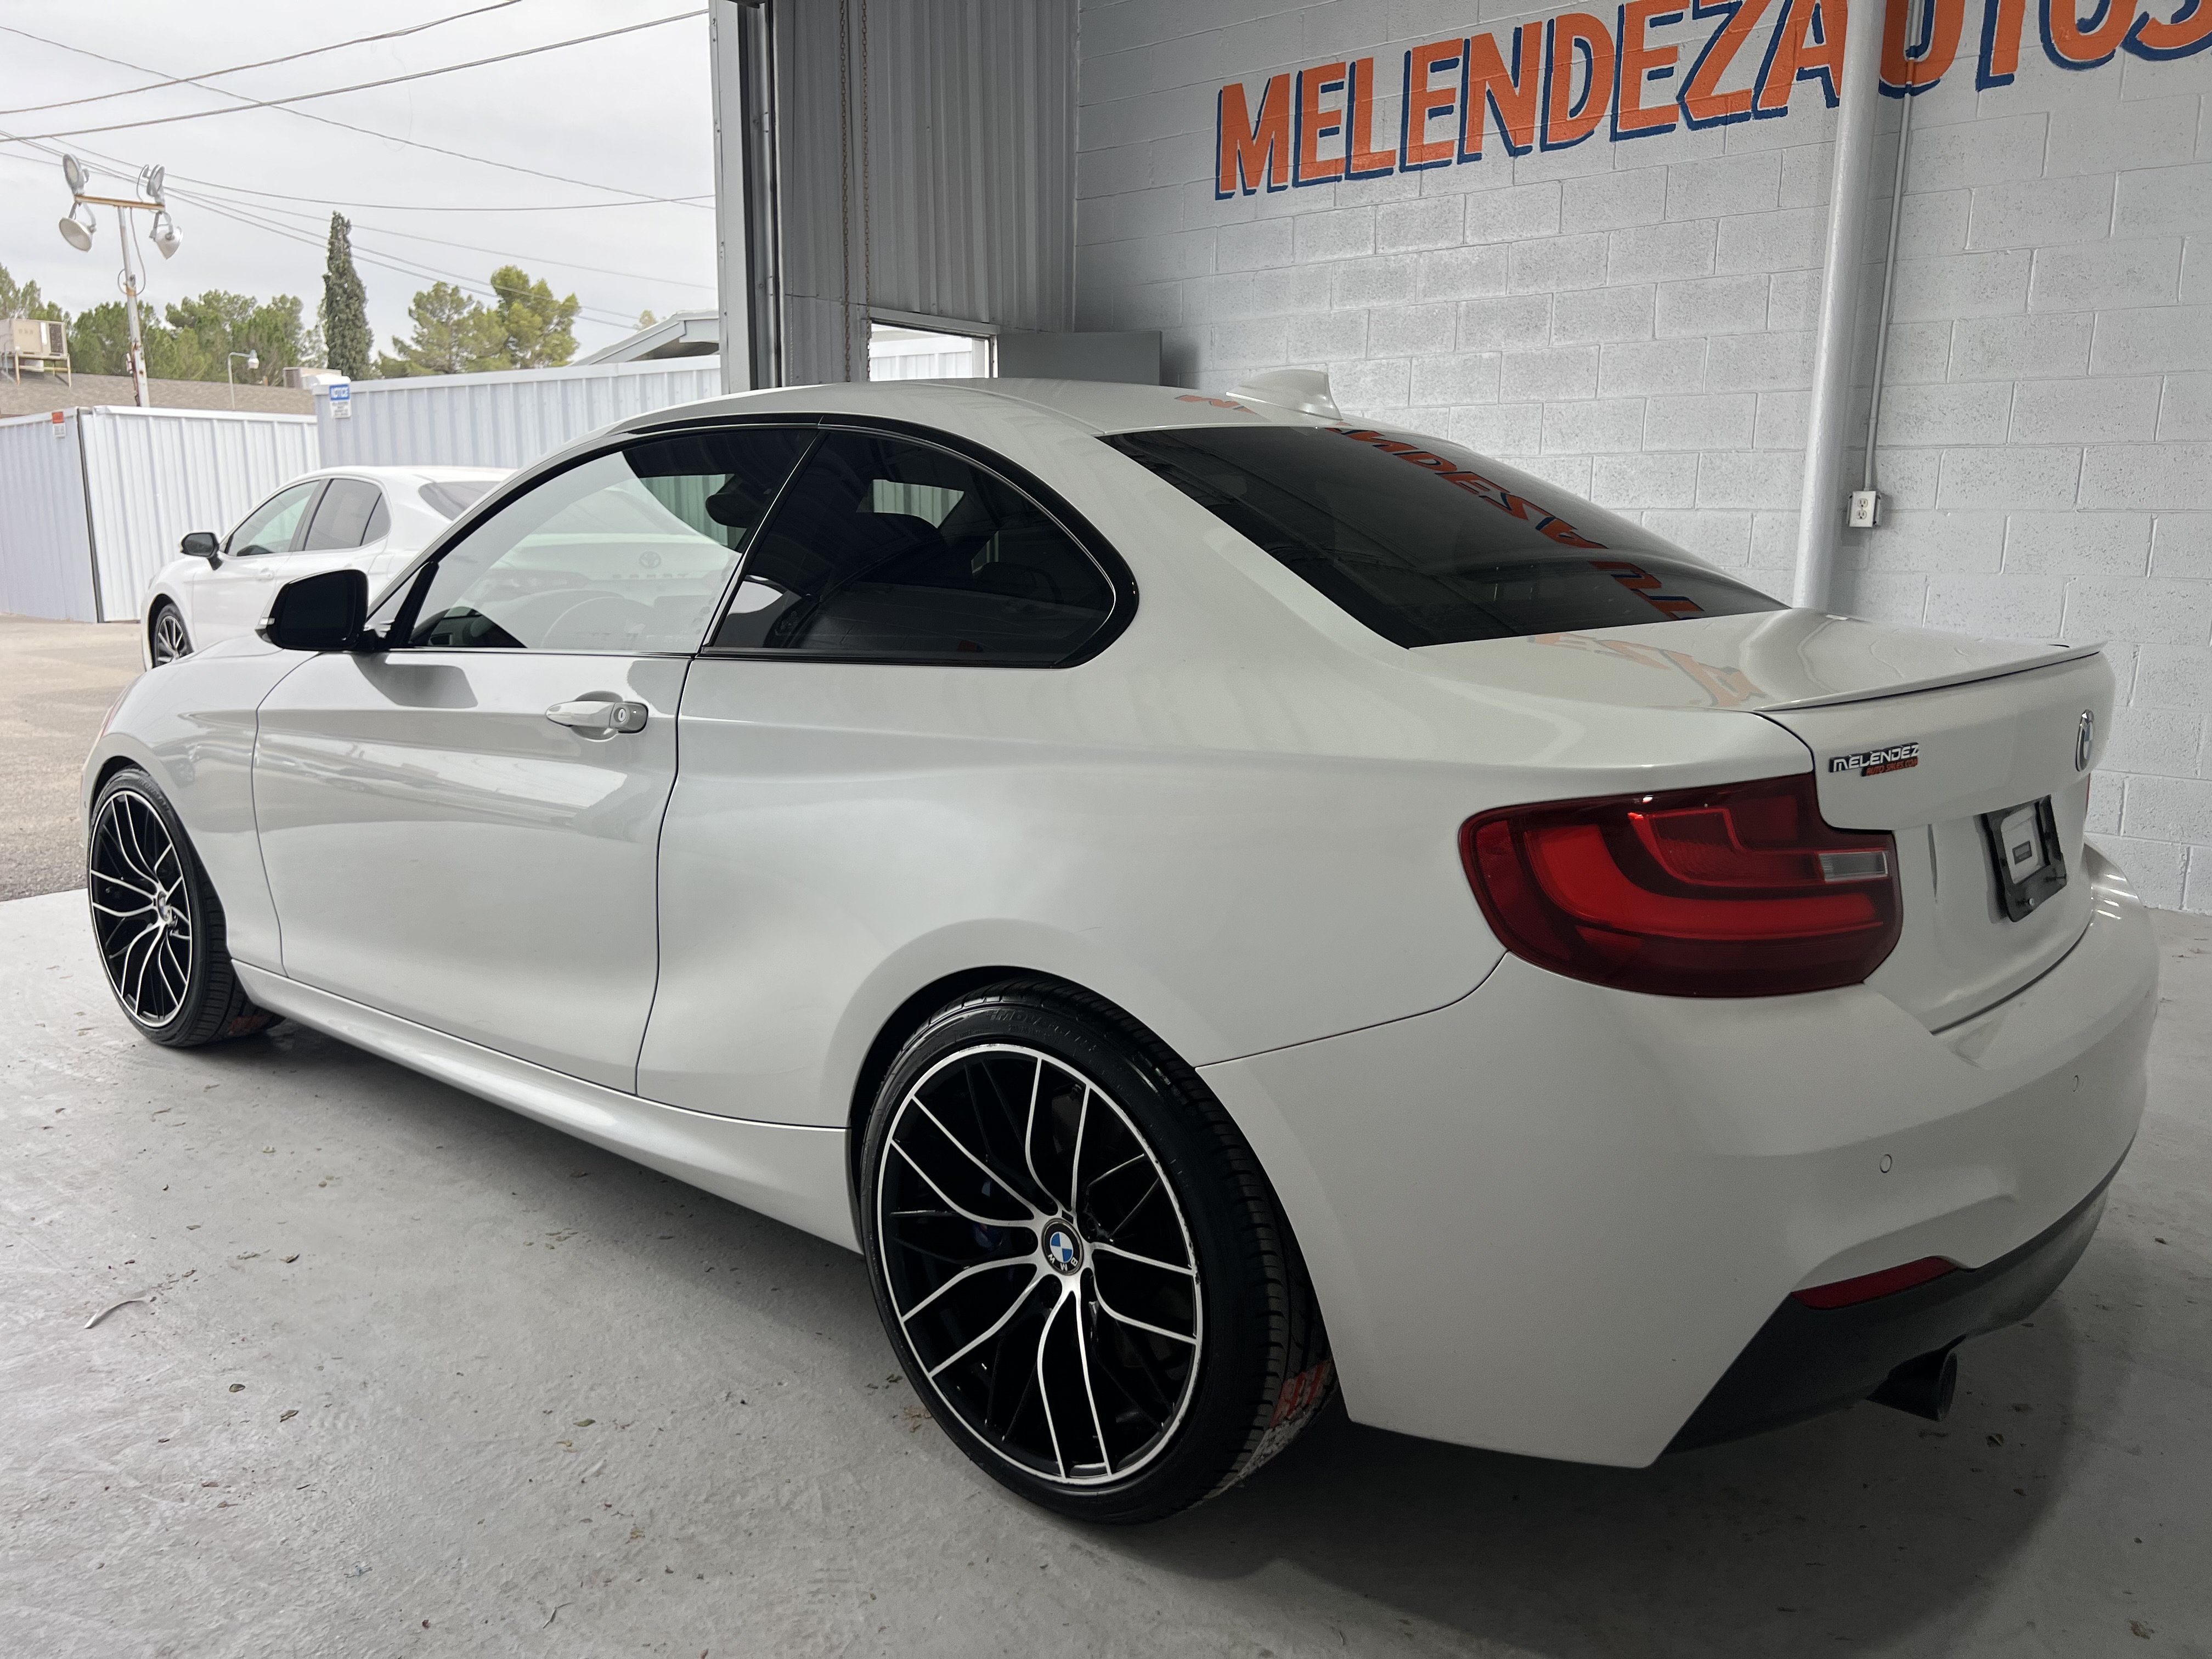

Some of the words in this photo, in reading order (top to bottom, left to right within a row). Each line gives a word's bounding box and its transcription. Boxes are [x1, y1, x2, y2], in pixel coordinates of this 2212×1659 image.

[1215, 0, 1773, 201] MELENDEZ
[1833, 744, 1920, 772] MELENDEZ
[1866, 766, 1884, 776] AUTO
[1047, 1254, 1079, 1272] BMW
